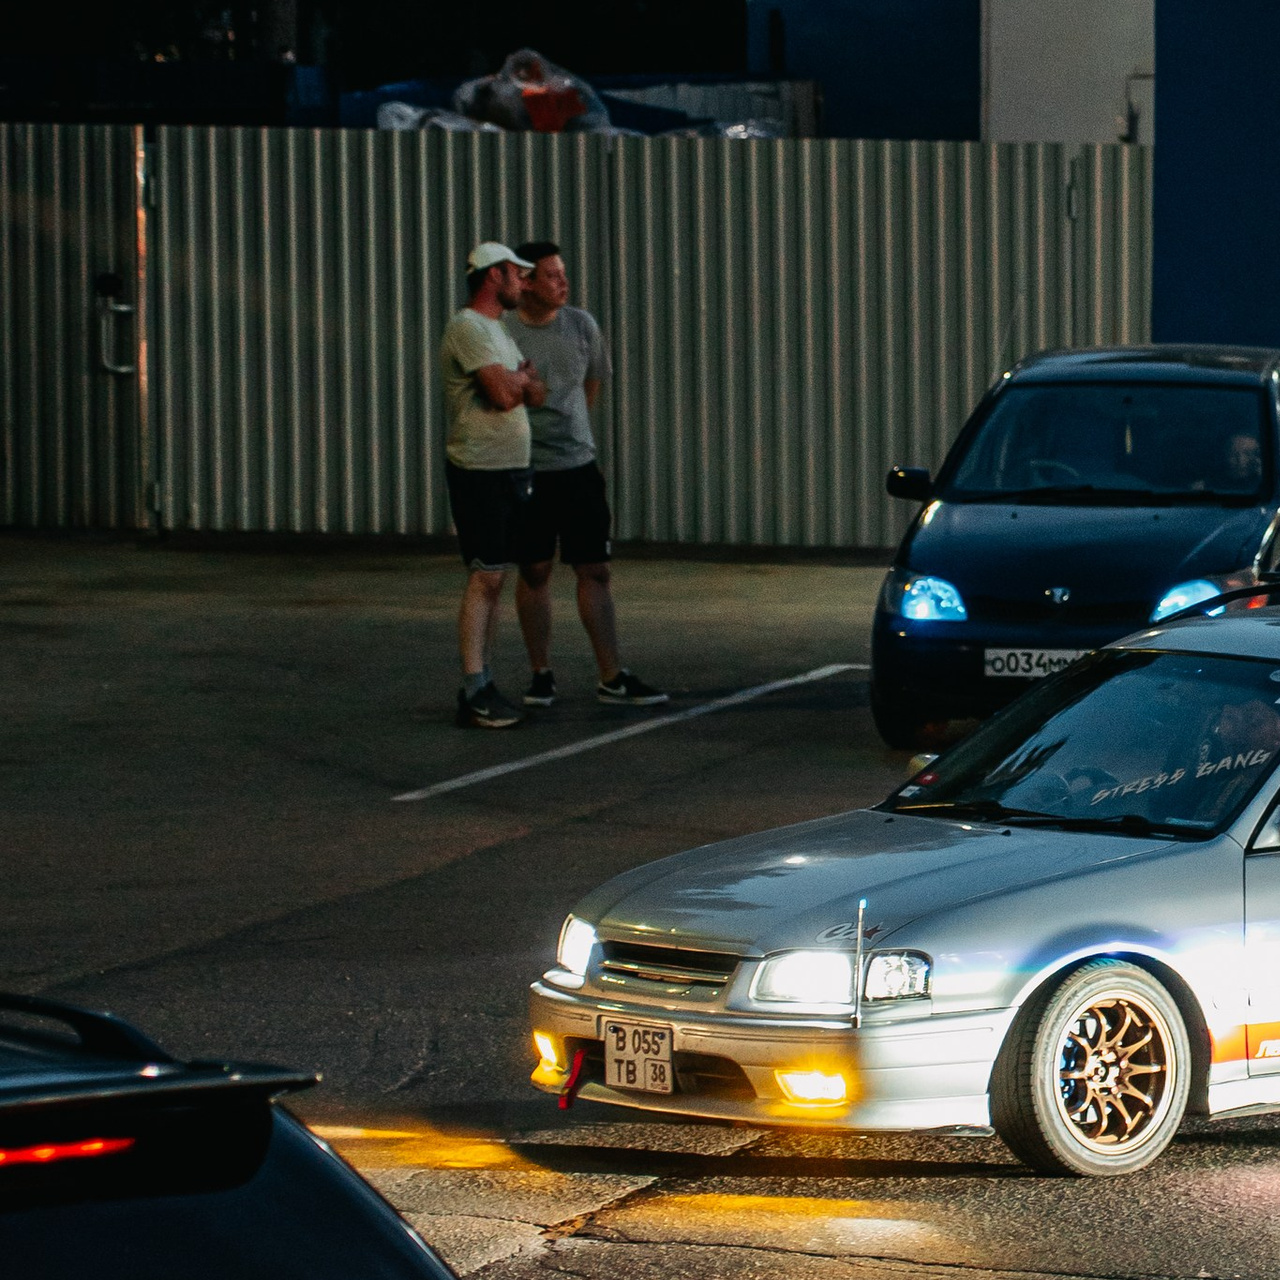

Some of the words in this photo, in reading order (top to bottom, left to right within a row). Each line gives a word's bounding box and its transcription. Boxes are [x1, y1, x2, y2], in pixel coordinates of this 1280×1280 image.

[1195, 749, 1272, 778] GANG
[632, 1029, 664, 1055] 055
[651, 1063, 666, 1083] 38
